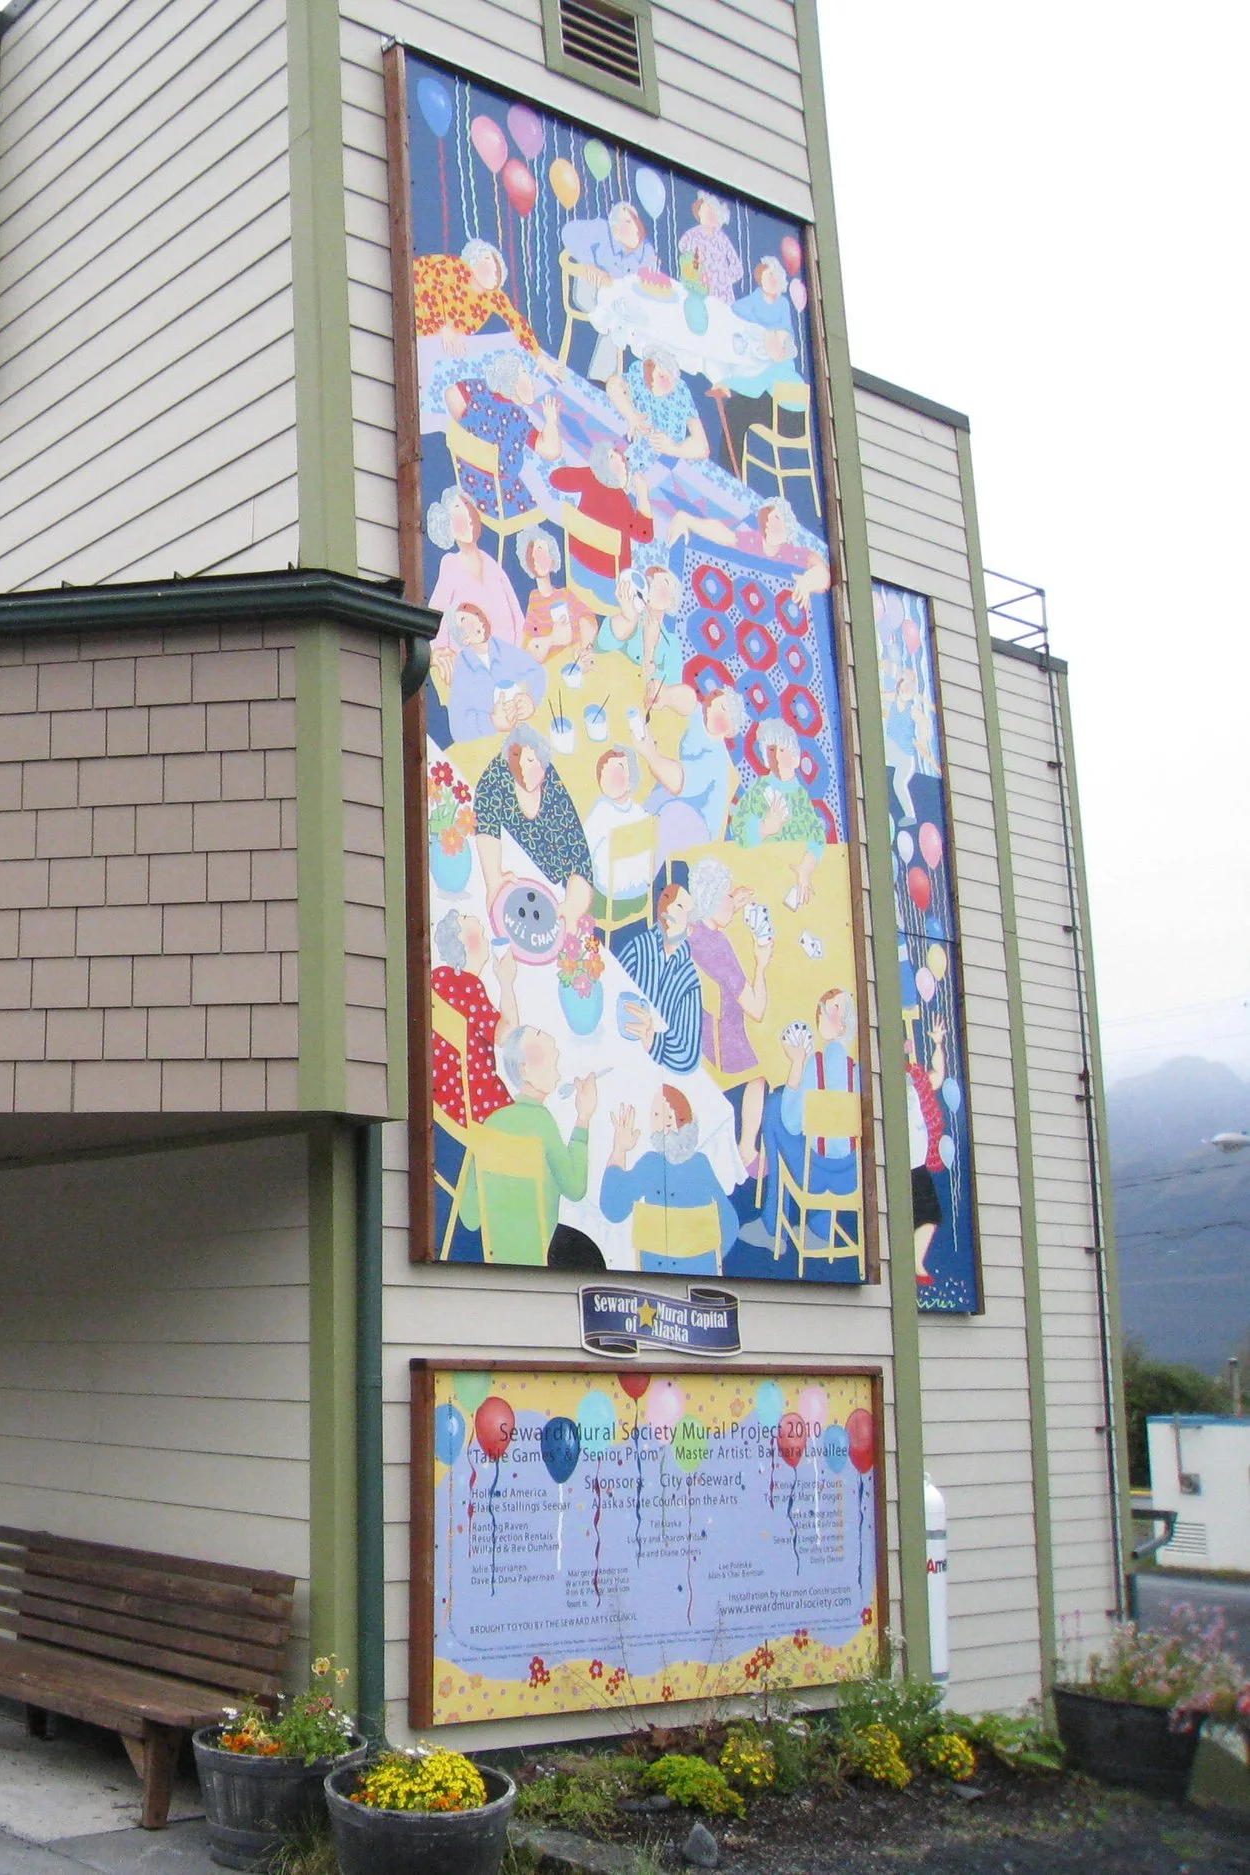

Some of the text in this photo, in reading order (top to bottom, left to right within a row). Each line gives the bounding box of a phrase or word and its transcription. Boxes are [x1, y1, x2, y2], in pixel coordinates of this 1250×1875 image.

[594, 1294, 728, 1331] Seward Mural Capital
[625, 1315, 688, 1343] of Alaska
[500, 1421, 821, 1446] Seward Mural Society Mural Project 2010
[676, 1446, 713, 1460] Master
[718, 1445, 751, 1460] Artist:
[758, 1444, 800, 1459] Barbara
[805, 1443, 848, 1457] Lavallee
[660, 1472, 681, 1489] City
[686, 1473, 698, 1487] of
[700, 1471, 742, 1487] Seward
[510, 1488, 547, 1498] America
[653, 1495, 688, 1507] Council
[703, 1493, 717, 1505] the
[719, 1493, 738, 1505] Arts
[502, 1501, 540, 1514] Stallings
[505, 1521, 528, 1531] Raven
[525, 1530, 553, 1541] Rentals
[471, 1576, 490, 1585] Dave
[518, 1574, 555, 1584] Paperman
[728, 1591, 769, 1602] Installation
[770, 1590, 779, 1600] by
[808, 1586, 851, 1597] Construction
[720, 1596, 852, 1617] www.sewardmuralsociety.com
[470, 1623, 504, 1634] BROUGHT
[507, 1622, 518, 1632] TO
[518, 1621, 534, 1631] YOU
[535, 1620, 544, 1630] BY
[545, 1619, 559, 1629] THE
[560, 1616, 589, 1627] SEWARD
[590, 1615, 608, 1625] ARTS
